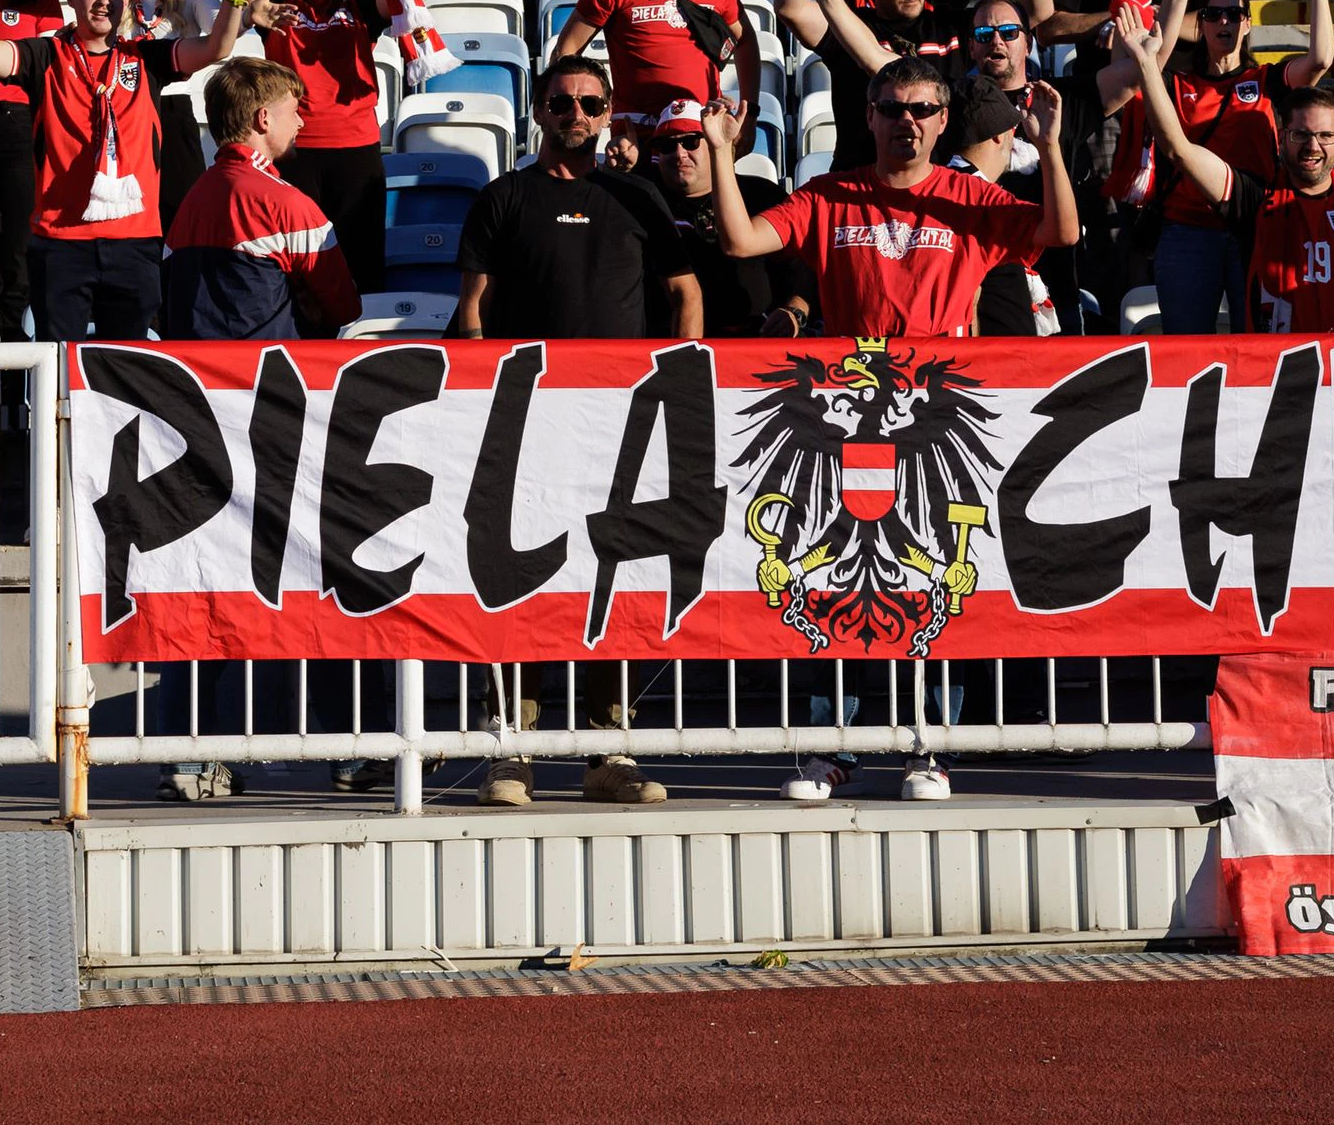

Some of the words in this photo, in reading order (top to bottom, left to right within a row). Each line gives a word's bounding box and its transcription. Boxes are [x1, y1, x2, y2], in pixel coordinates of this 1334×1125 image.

[556, 215, 591, 224] ellesse
[1303, 241, 1332, 284] 19
[76, 340, 727, 650] PIELA
